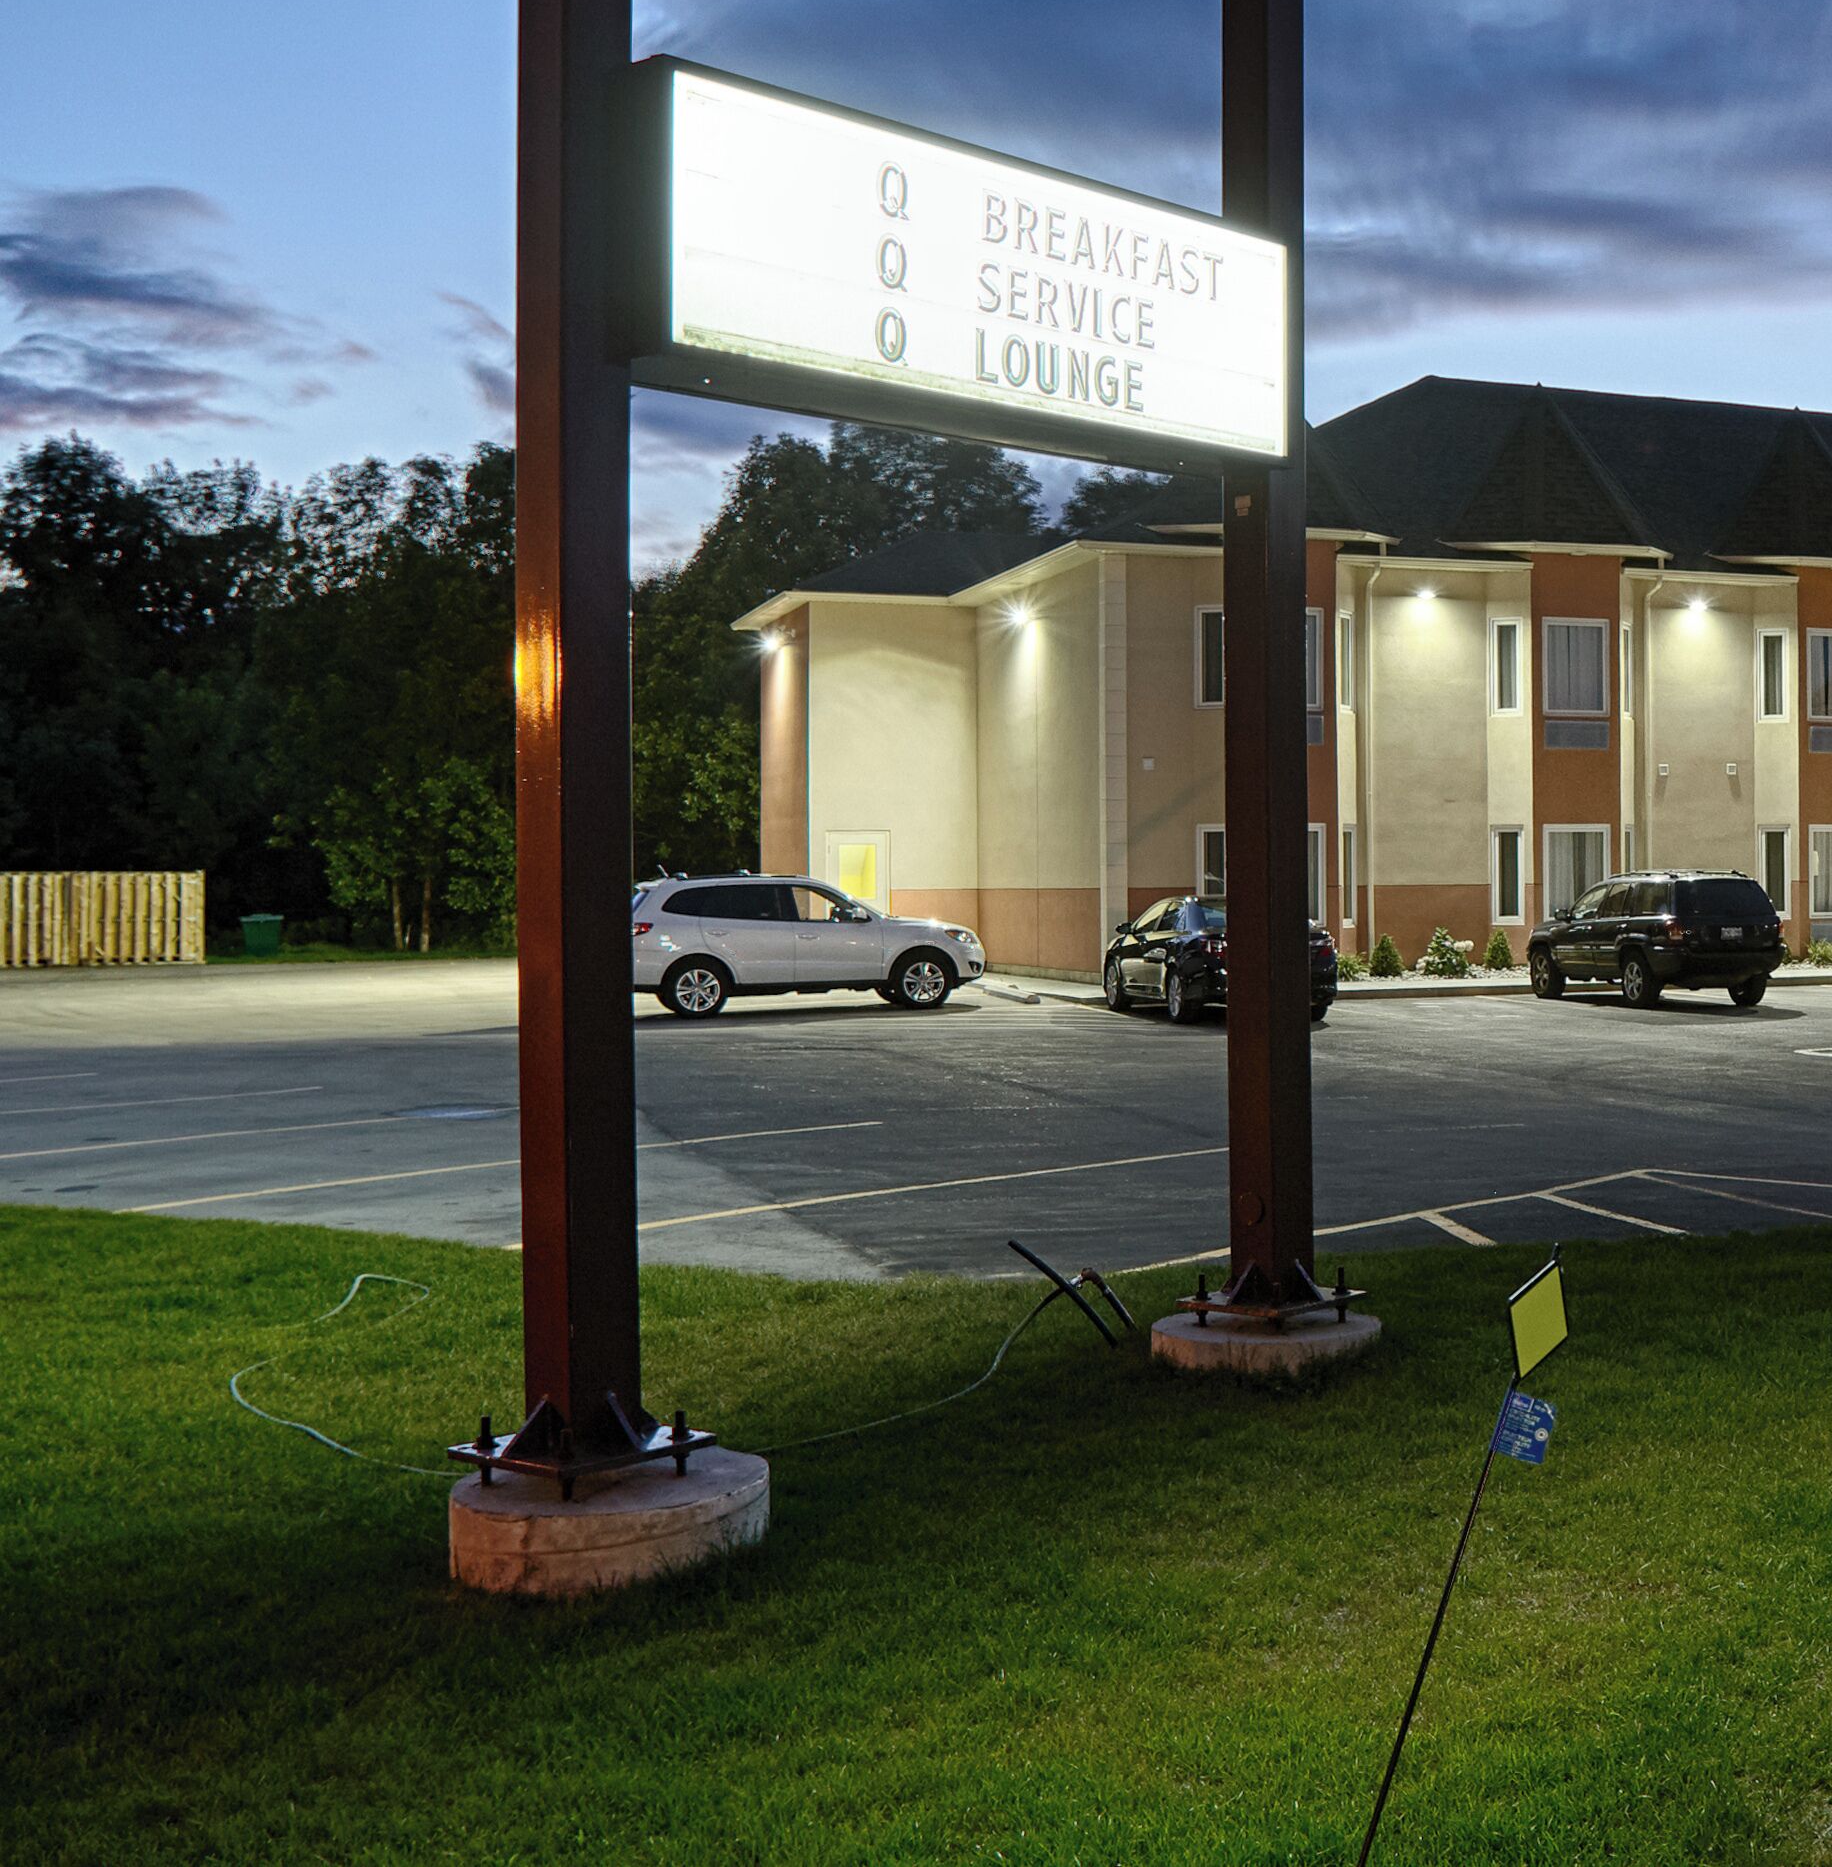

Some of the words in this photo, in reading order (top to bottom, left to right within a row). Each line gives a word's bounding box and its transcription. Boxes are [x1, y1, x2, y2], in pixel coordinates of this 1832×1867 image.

[879, 161, 910, 220] Q
[983, 190, 1222, 300] BREAKFAST
[877, 234, 908, 293] Q
[978, 262, 1154, 348] SERVICE
[876, 307, 908, 366] Q
[976, 328, 1143, 412] LOUNGE
